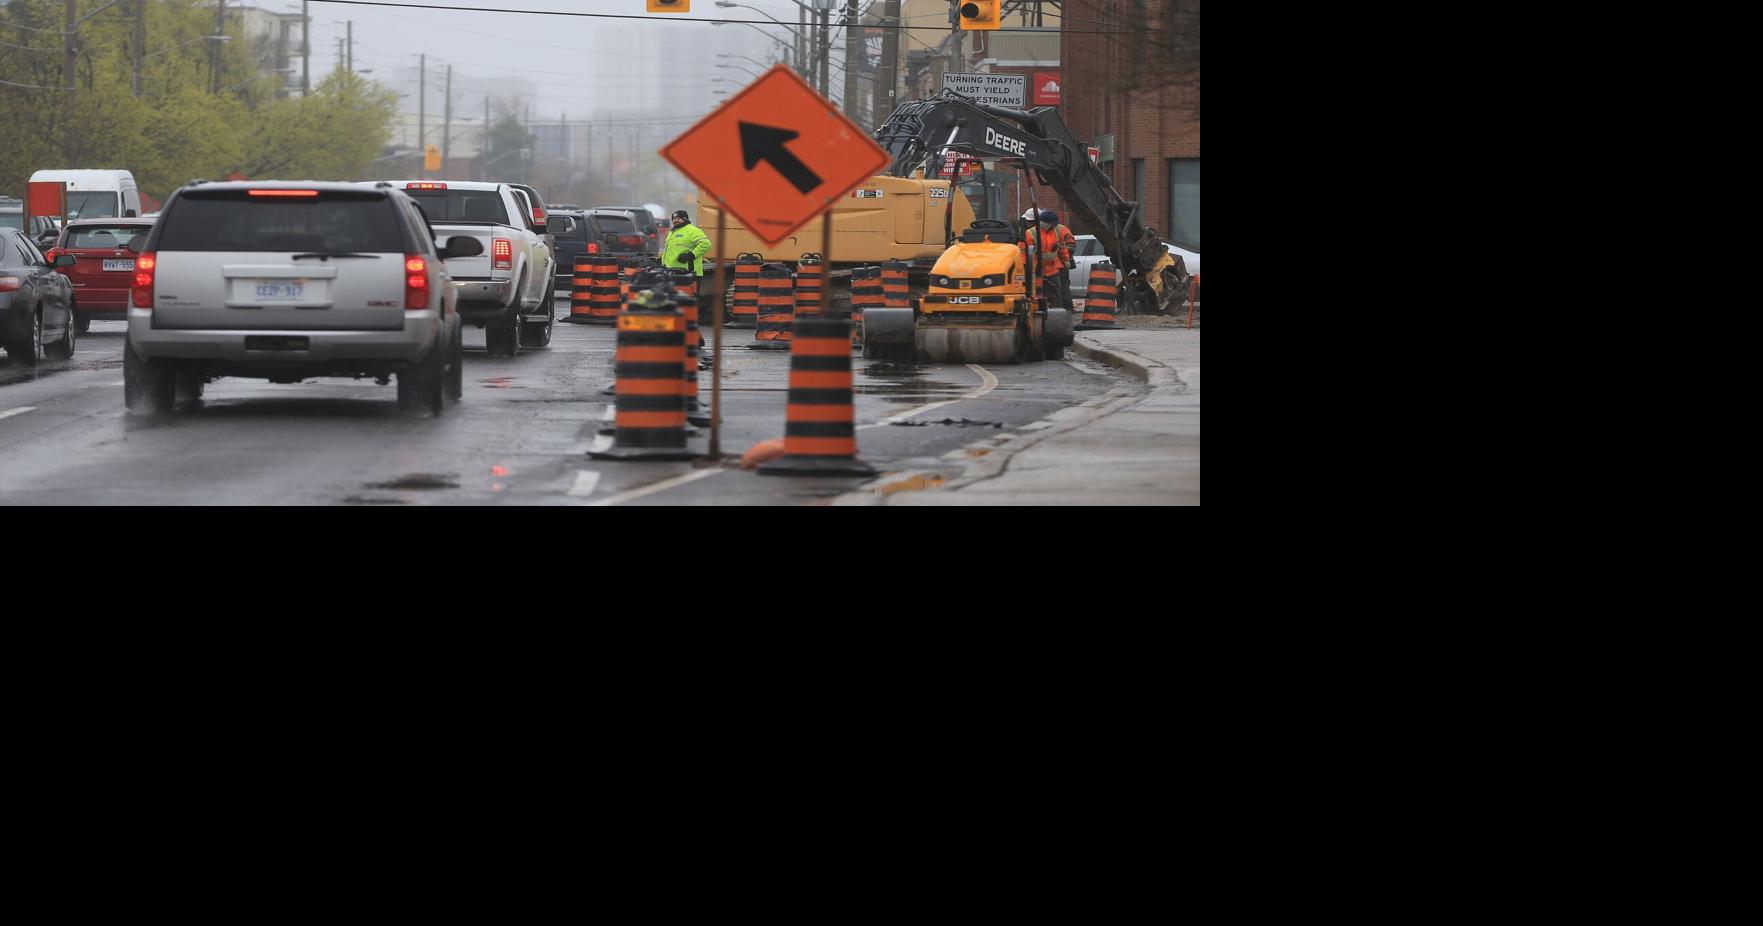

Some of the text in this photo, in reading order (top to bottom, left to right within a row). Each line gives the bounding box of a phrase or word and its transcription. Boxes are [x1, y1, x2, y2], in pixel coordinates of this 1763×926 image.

[945, 75, 1023, 85] TURNING TRAFFIC
[983, 86, 1010, 94] YIELD
[967, 96, 1021, 105] ESTRIANS
[985, 126, 1027, 157] DEERE
[949, 296, 981, 304] JCB
